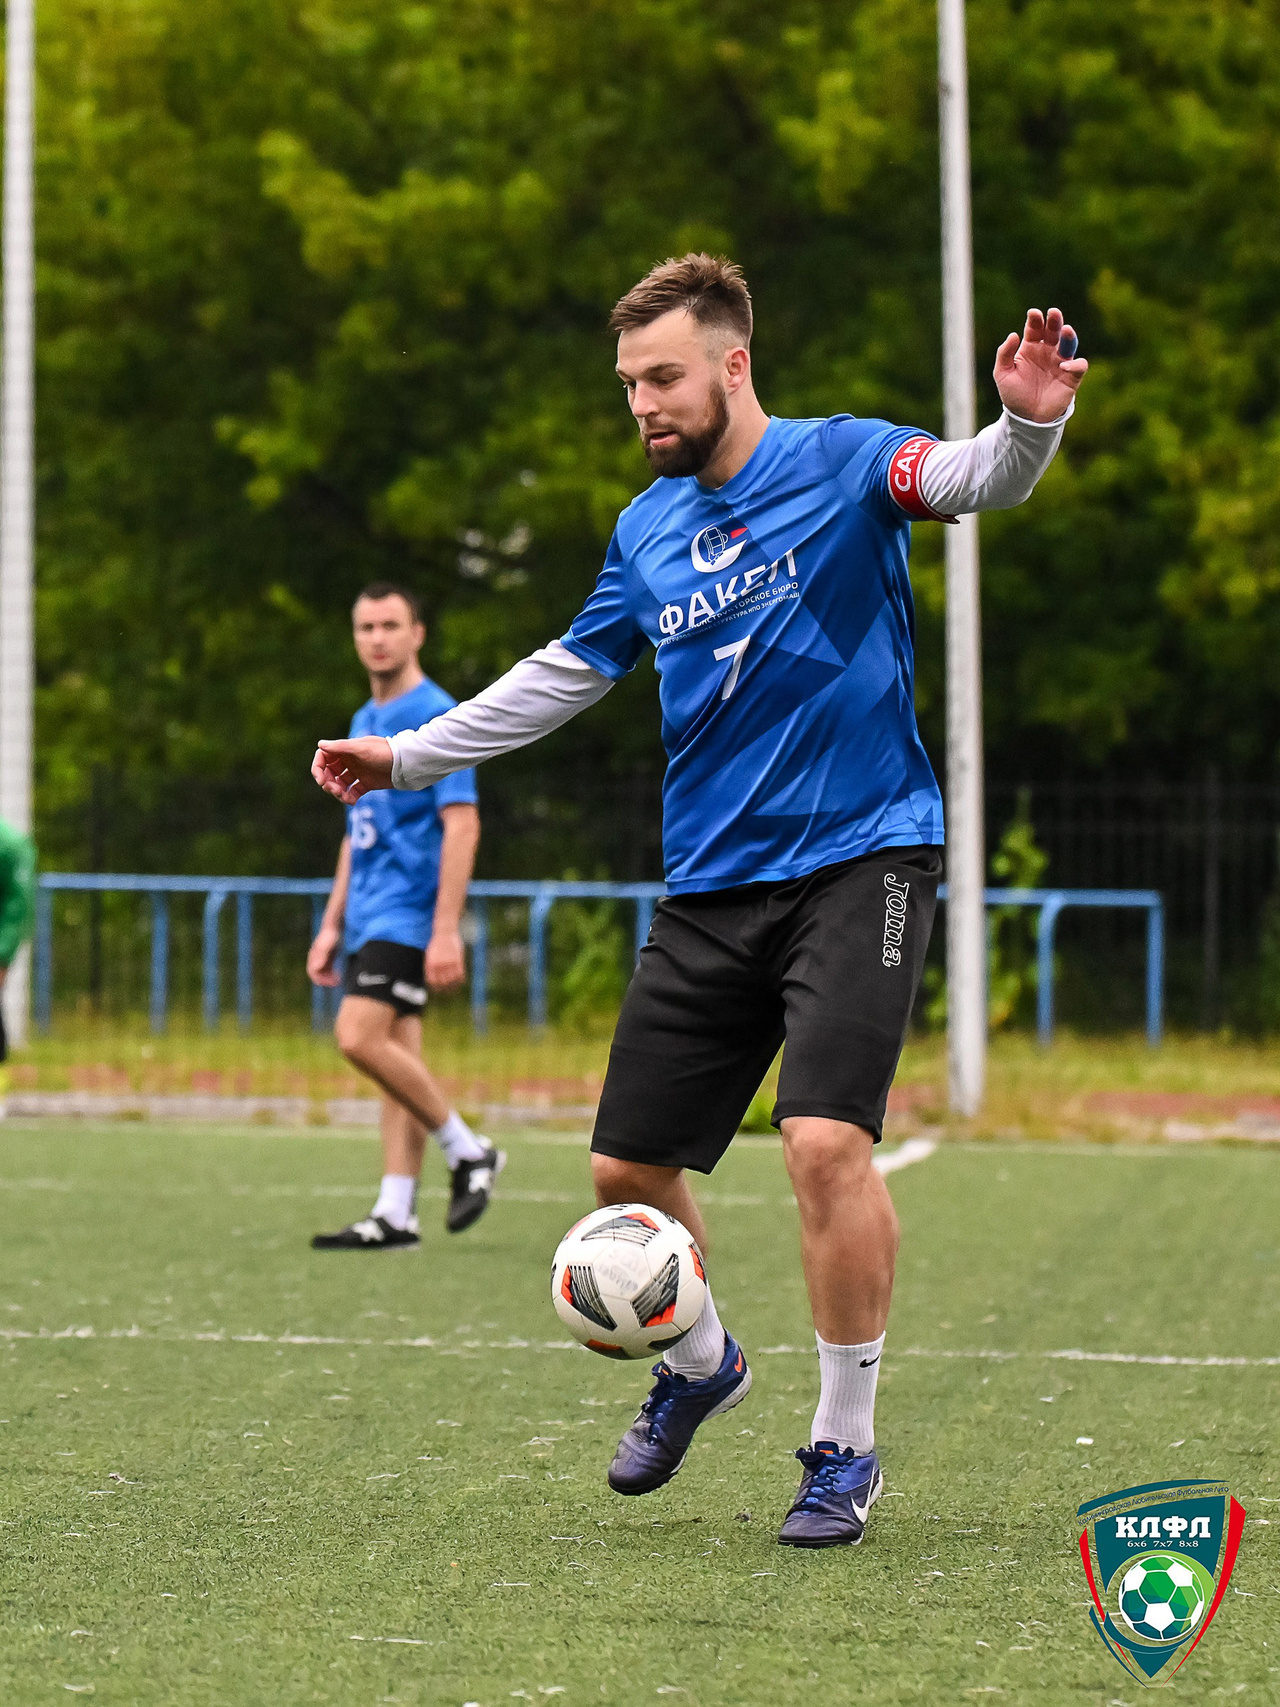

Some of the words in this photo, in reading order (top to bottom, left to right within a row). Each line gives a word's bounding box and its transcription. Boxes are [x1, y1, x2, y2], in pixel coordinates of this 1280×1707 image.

[658, 548, 797, 636] ФАКЕЛ
[772, 582, 799, 595] БЮРО
[713, 634, 751, 700] 7
[882, 873, 910, 967] Joma
